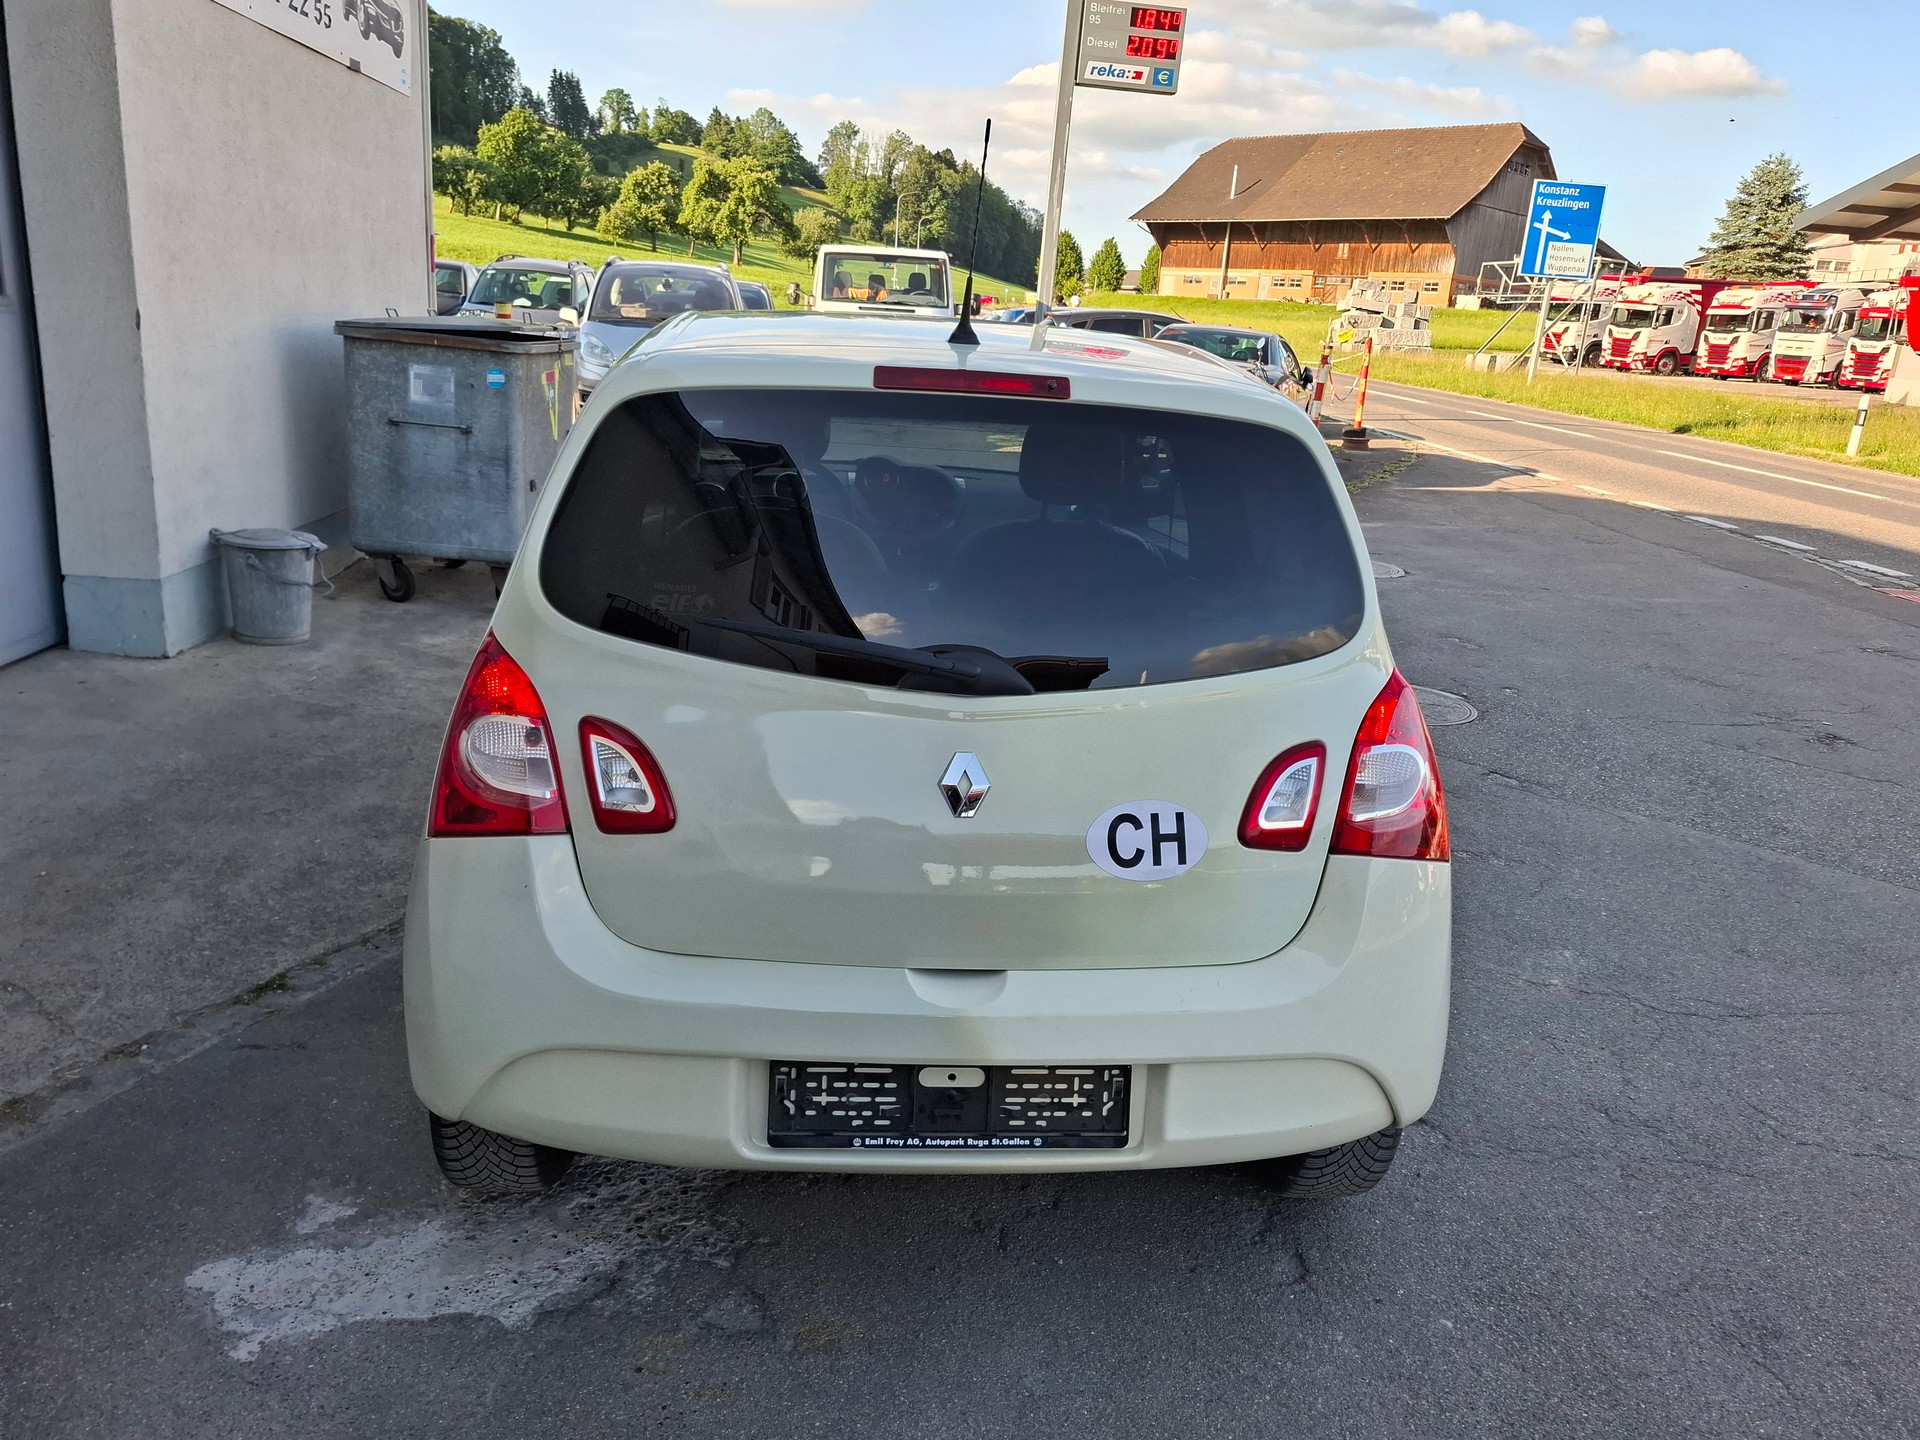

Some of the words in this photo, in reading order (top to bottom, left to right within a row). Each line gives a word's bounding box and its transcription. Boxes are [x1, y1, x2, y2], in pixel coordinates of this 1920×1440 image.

[314, 0, 332, 28] 55
[1090, 2, 1126, 15] Bleifrei
[1089, 14, 1101, 24] 95
[1087, 36, 1118, 49] Diesel
[1539, 184, 1580, 196] Konstanz
[1537, 196, 1590, 210] Kreuzlingen
[1551, 244, 1574, 253] Nollen
[1549, 254, 1586, 263] Hosenruck
[1548, 264, 1585, 273] Wuppenau
[1107, 812, 1187, 868] CH
[865, 1137, 884, 1145] Emil
[886, 1138, 904, 1146] Frey
[906, 1138, 922, 1146] AG,
[925, 1137, 965, 1147] Autopark
[967, 1138, 989, 1147] Ruga
[991, 1137, 1030, 1146] St.Gallen
